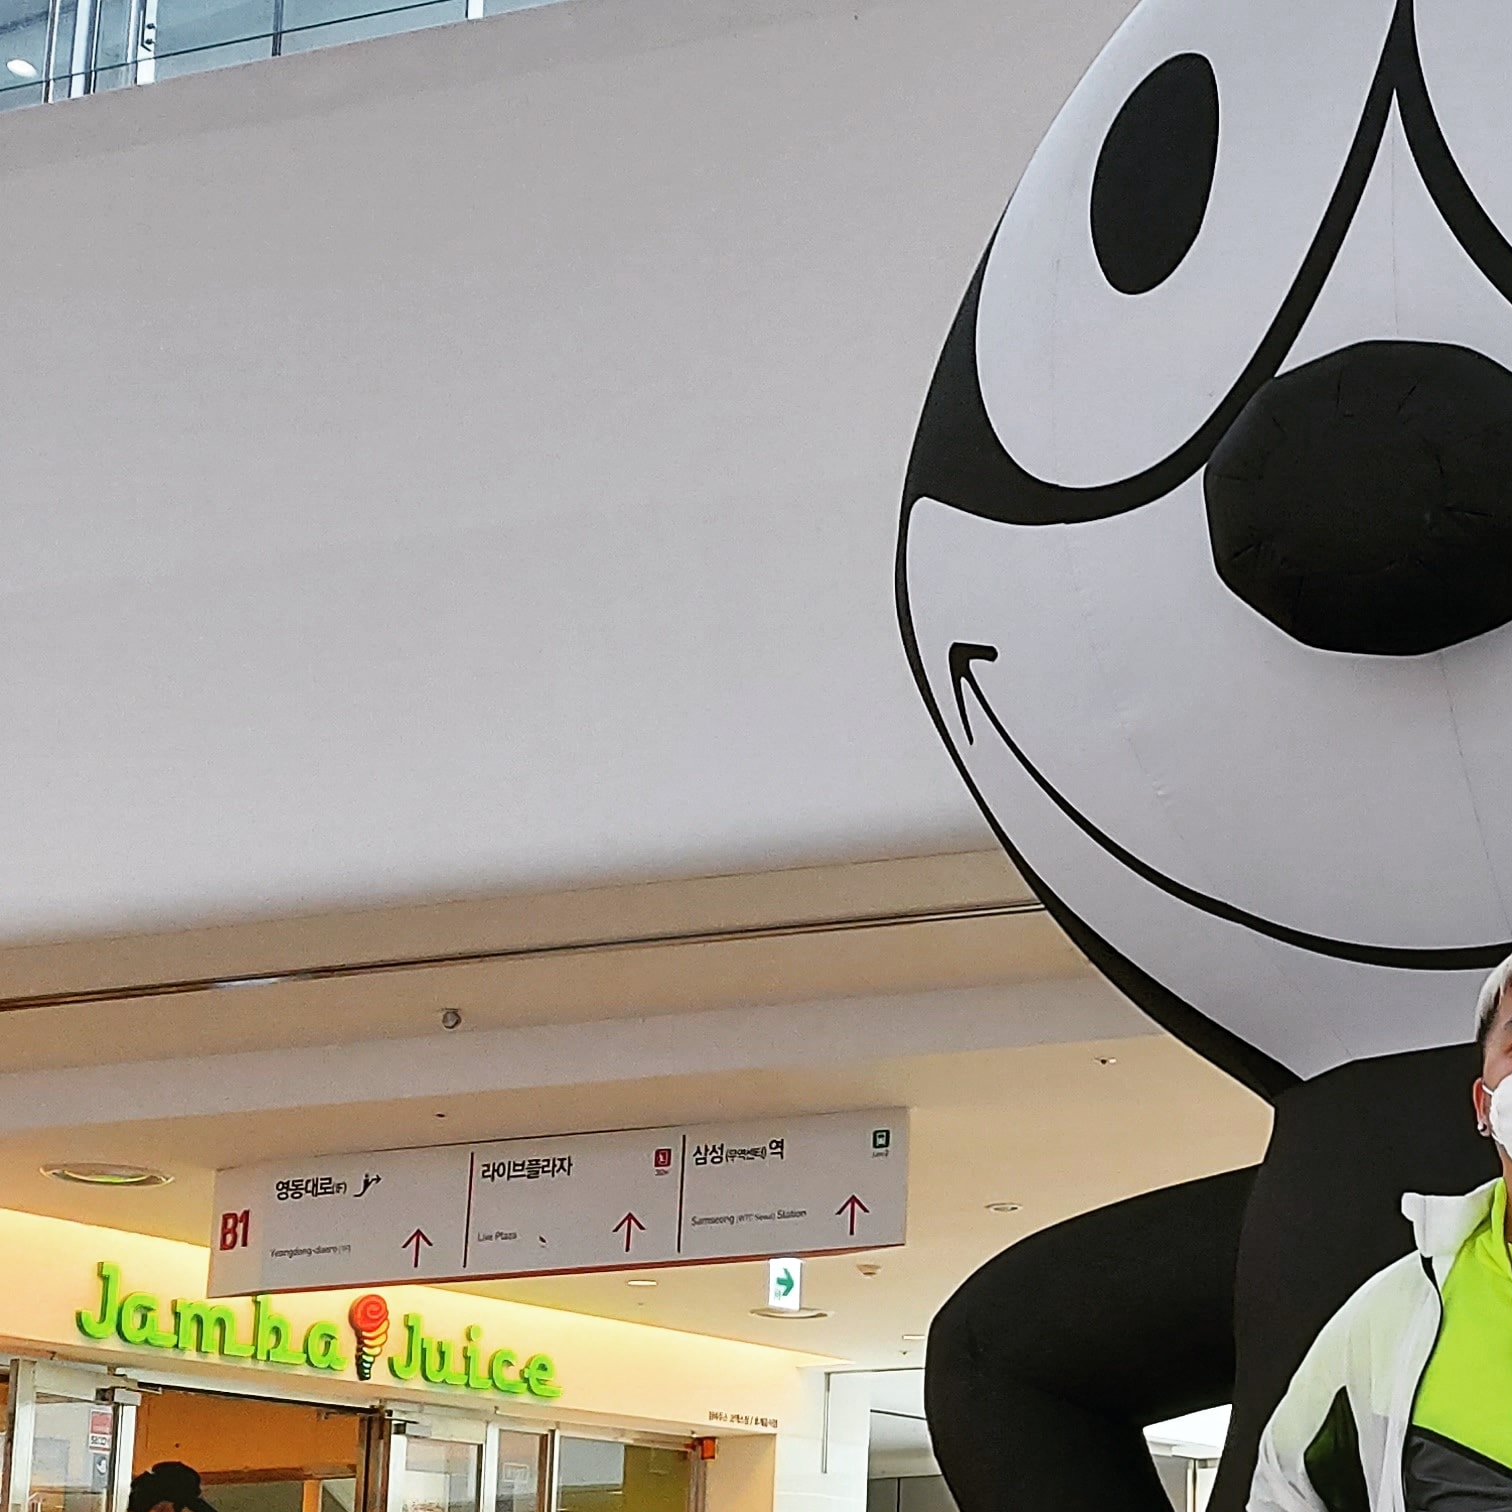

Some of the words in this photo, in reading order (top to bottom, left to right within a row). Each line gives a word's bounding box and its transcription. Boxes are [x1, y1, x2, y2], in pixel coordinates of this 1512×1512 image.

[481, 1155, 574, 1183] 라이브플라자
[219, 1209, 251, 1251] B1
[76, 1261, 347, 1371] Jamba
[388, 1313, 562, 1398] Juice
